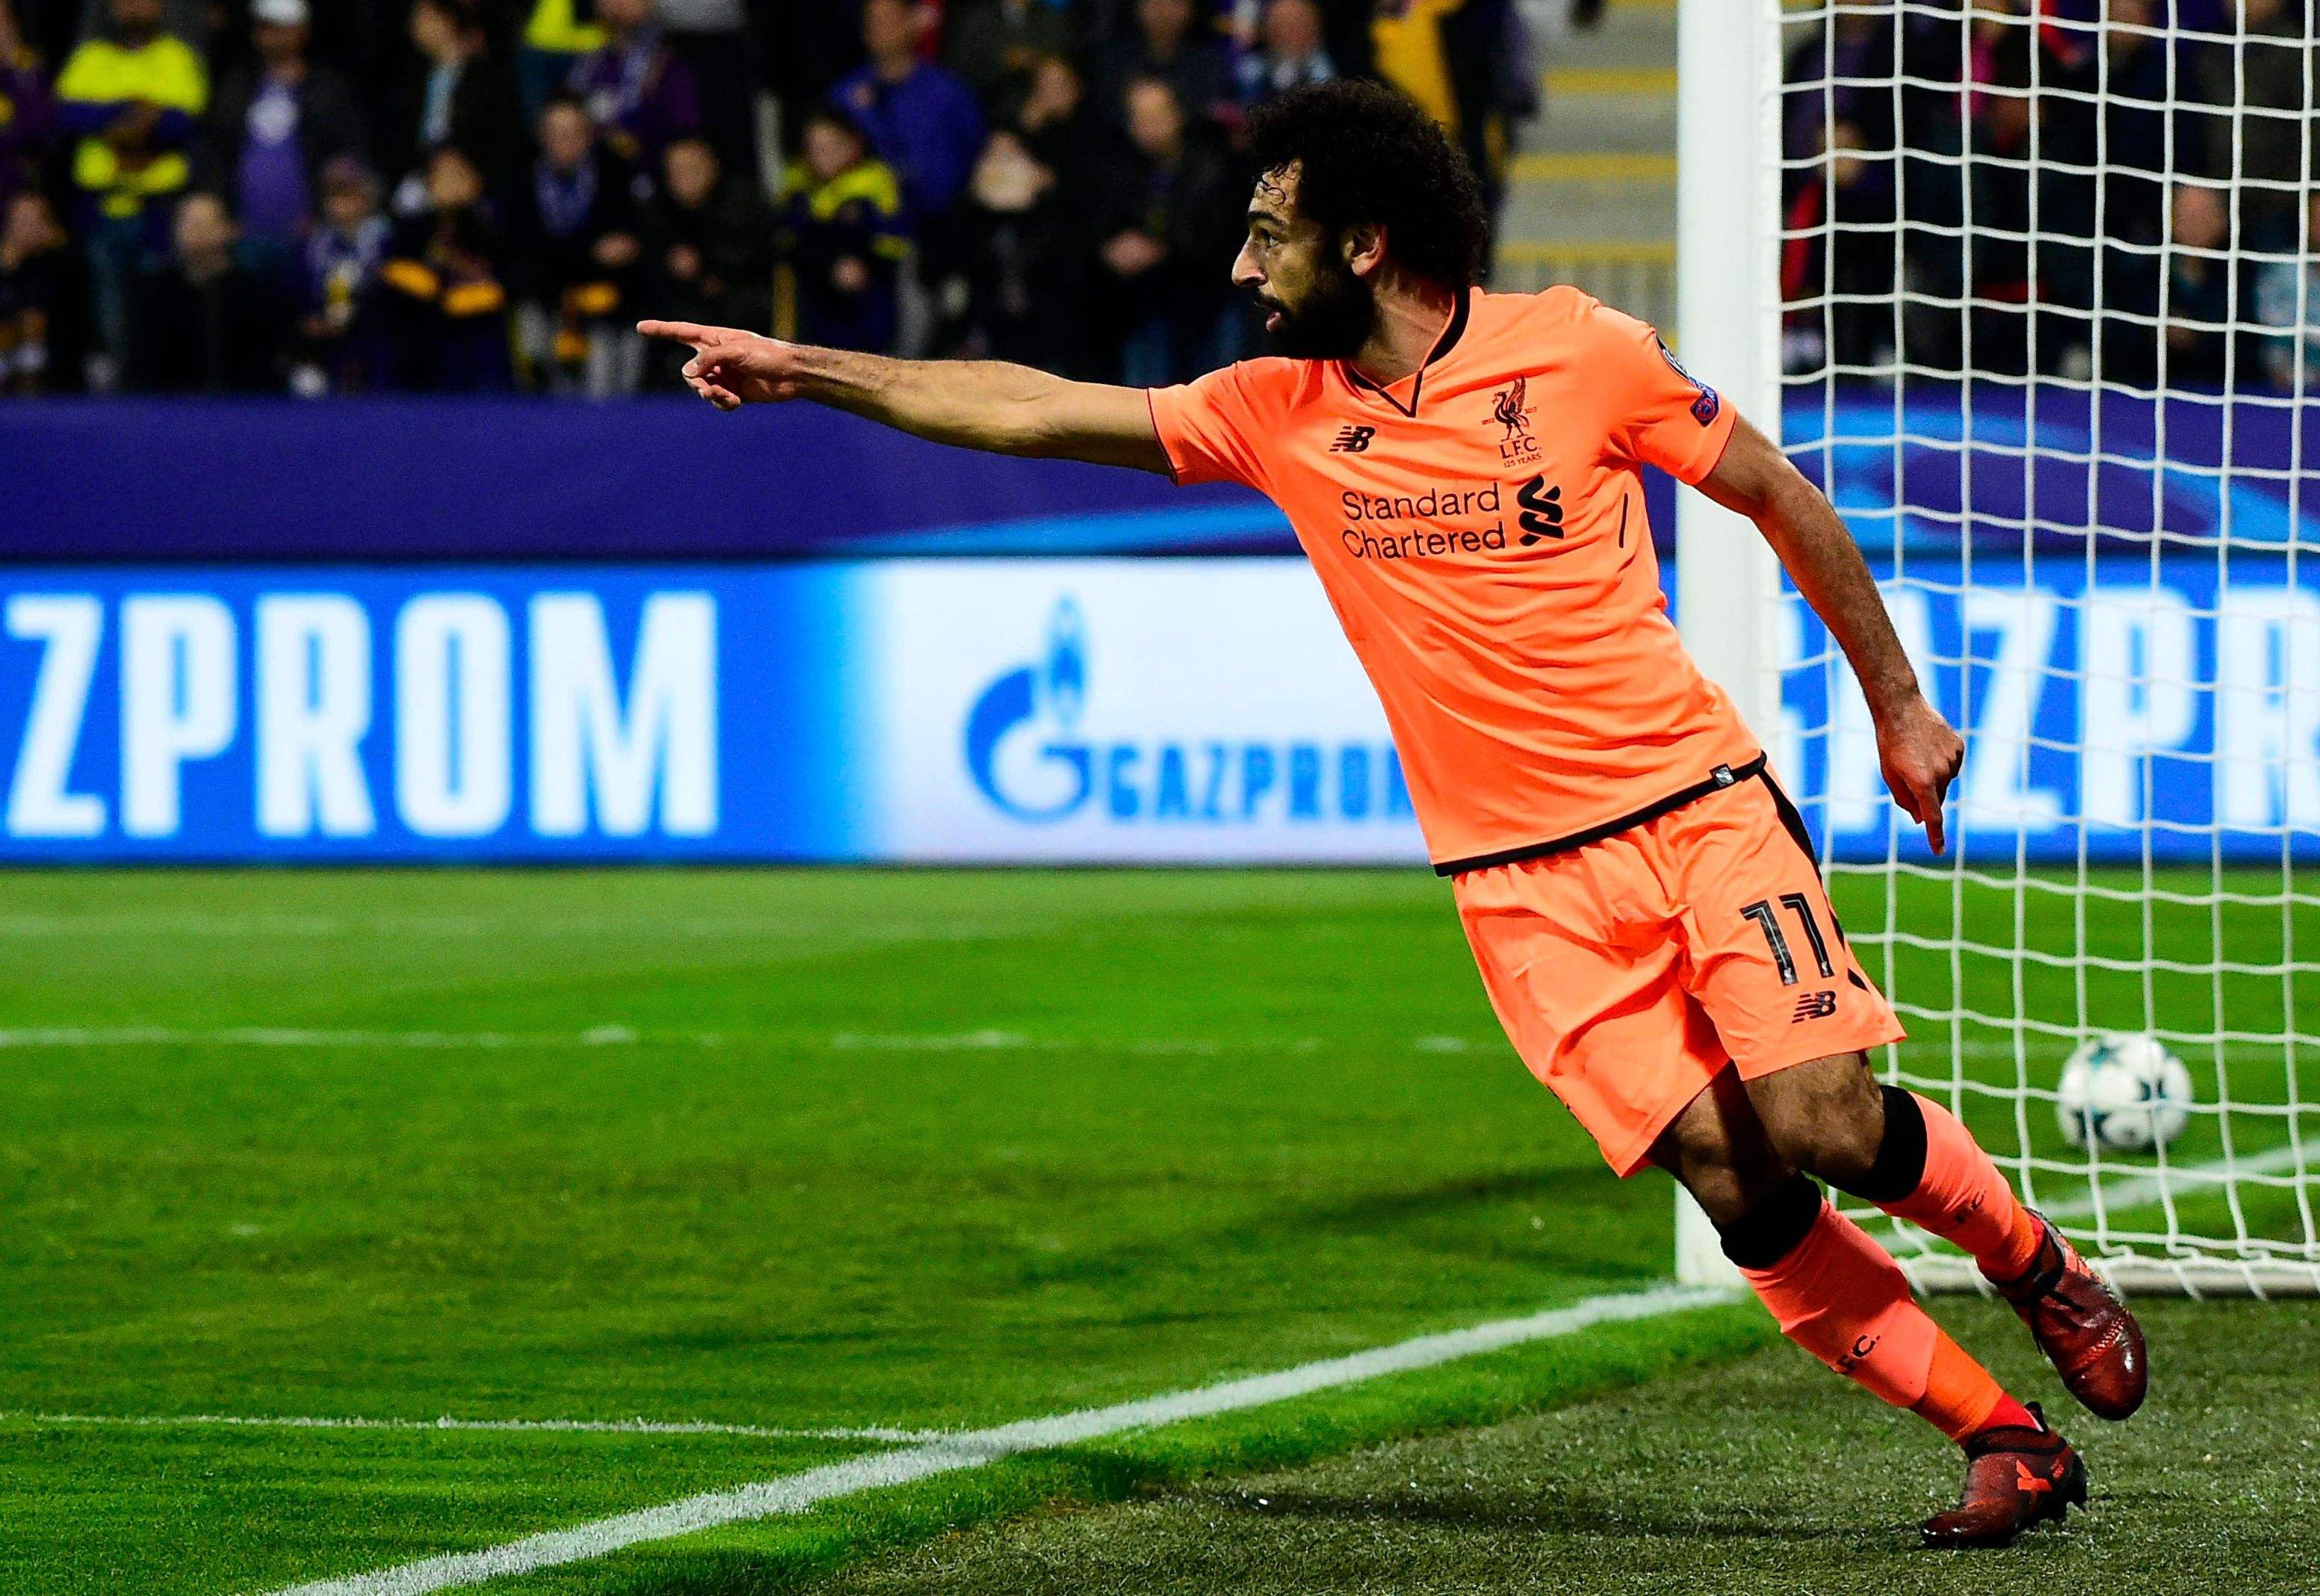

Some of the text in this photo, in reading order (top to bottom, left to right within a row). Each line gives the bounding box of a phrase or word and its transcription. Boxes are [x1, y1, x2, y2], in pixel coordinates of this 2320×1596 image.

[1517, 454, 1542, 465] YEARS
[1342, 482, 1500, 521] Standard
[1342, 521, 1506, 559] Chartered
[5, 592, 719, 838] ZPROM
[1739, 892, 1834, 986] 11
